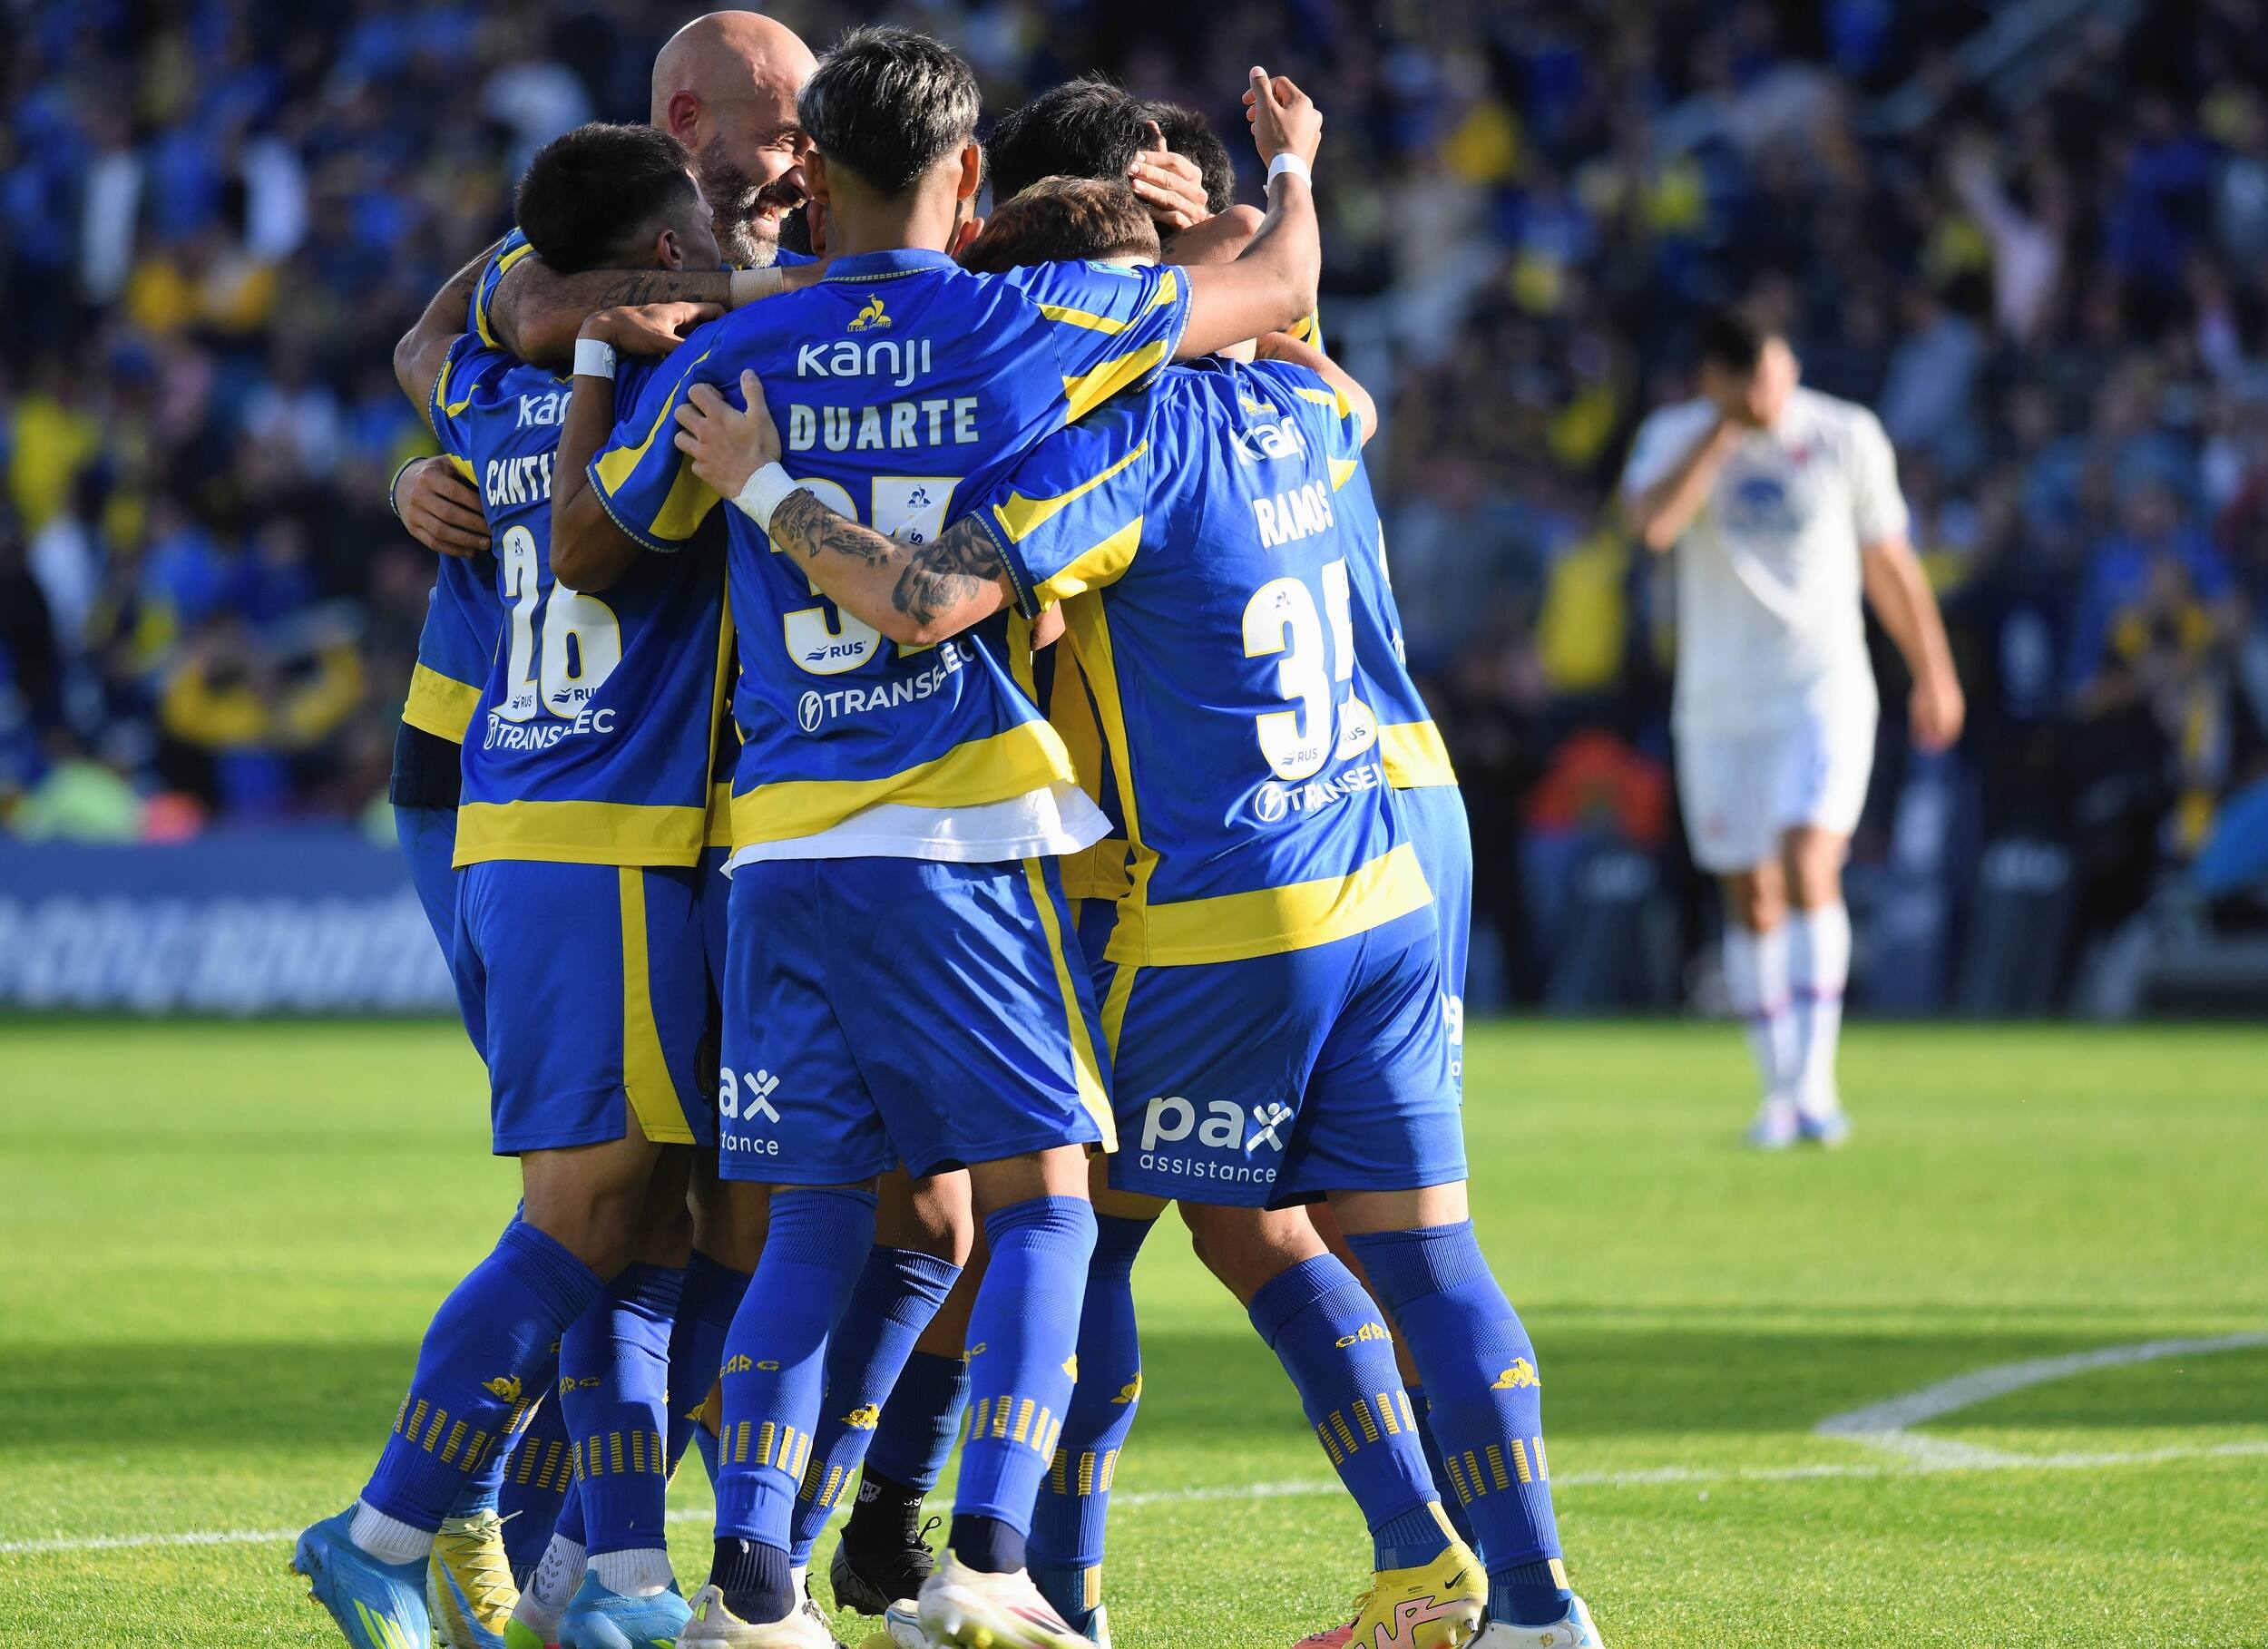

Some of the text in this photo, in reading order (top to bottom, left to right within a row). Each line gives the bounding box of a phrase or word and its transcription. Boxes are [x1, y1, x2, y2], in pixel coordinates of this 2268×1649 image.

[788, 396, 980, 452] DUARTE
[485, 452, 557, 507] CANTI
[1252, 478, 1334, 549] RAMOS
[489, 525, 621, 722] 26
[830, 641, 865, 659] RUS
[521, 695, 533, 708] RUS
[573, 688, 599, 702] RU
[496, 708, 617, 750] TRANSEC
[1297, 747, 1318, 763] RUS
[1140, 1096, 1292, 1152] pax
[1139, 1154, 1276, 1183] assistance
